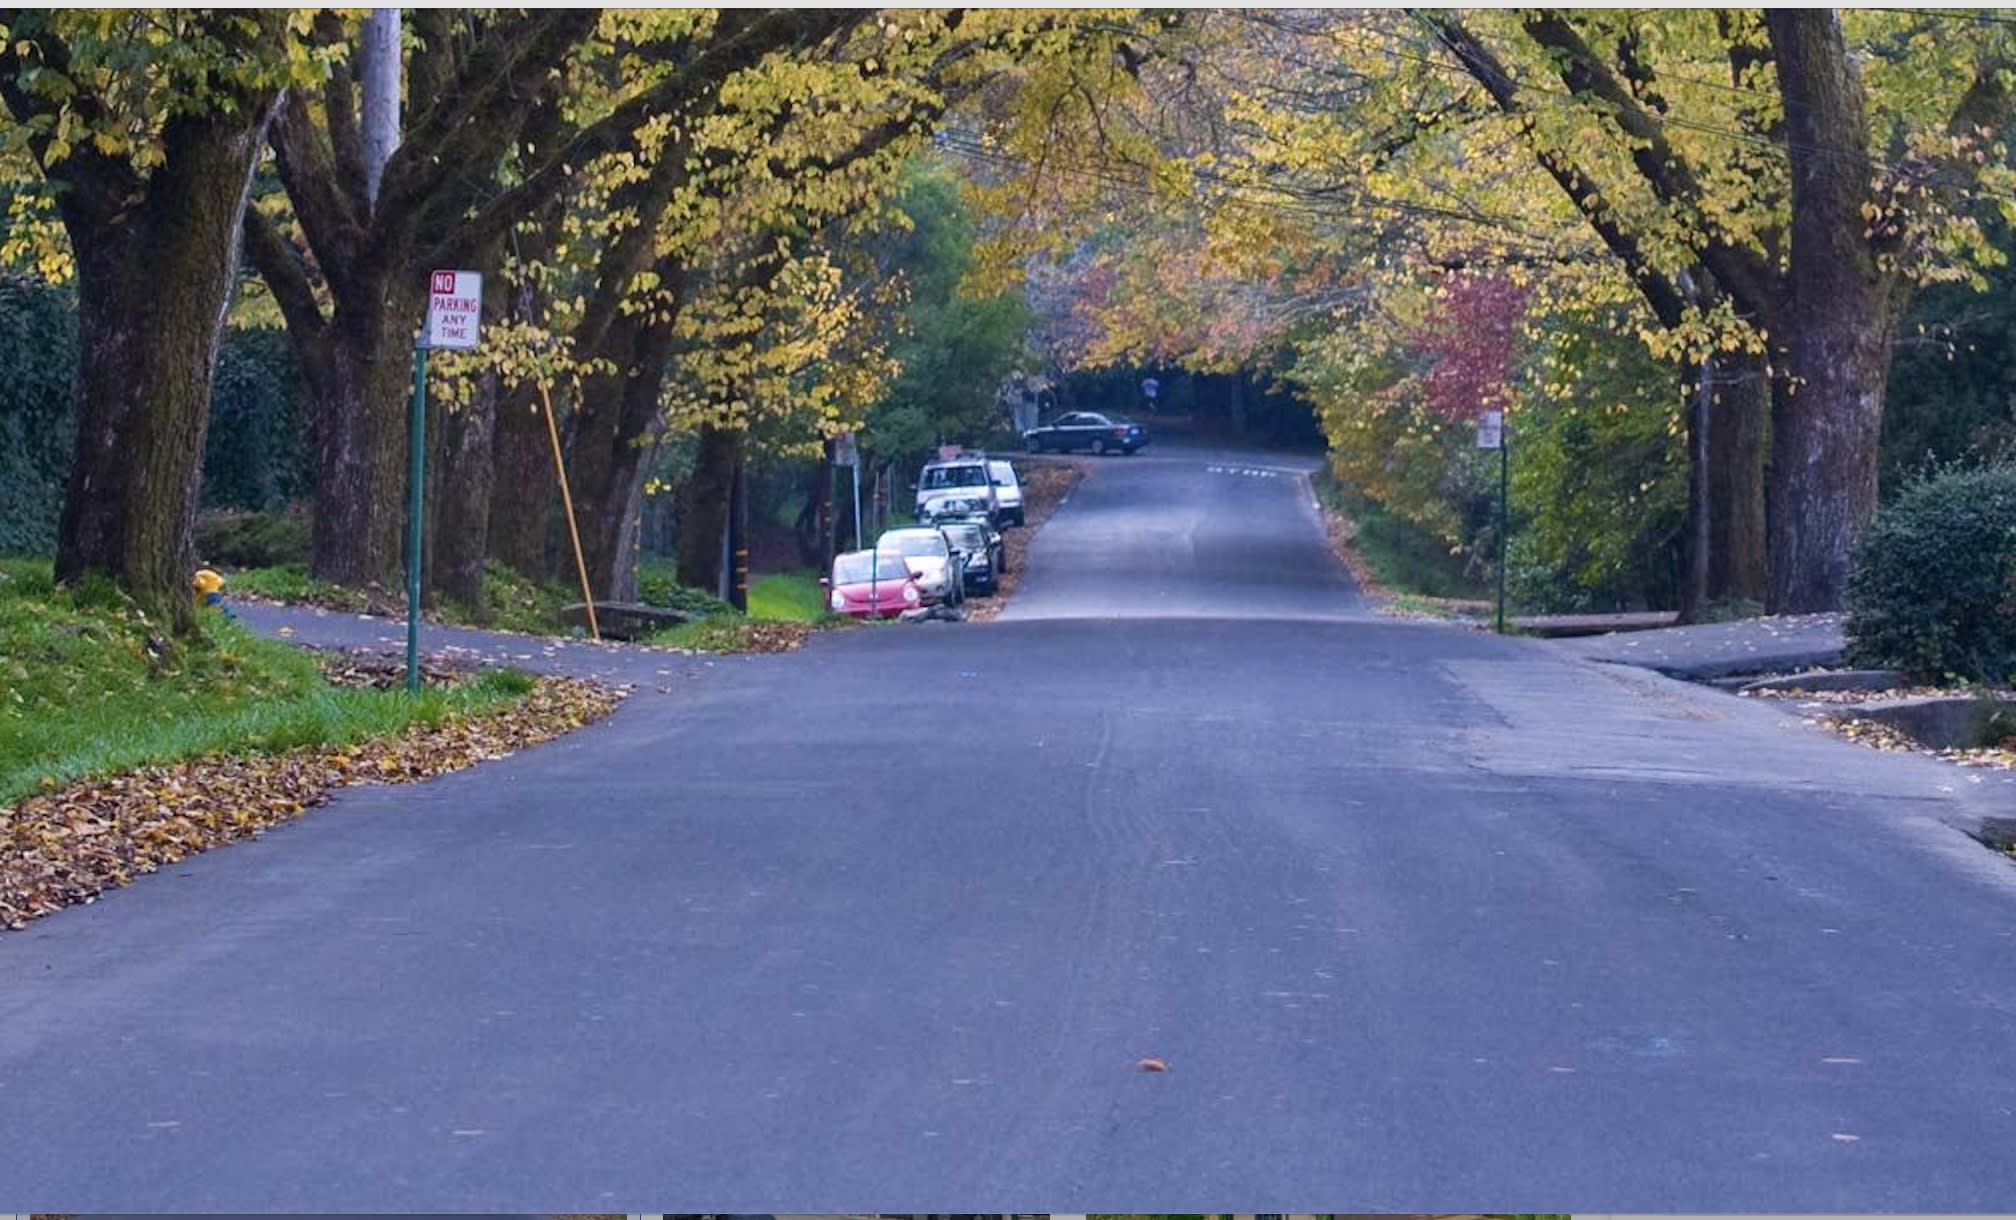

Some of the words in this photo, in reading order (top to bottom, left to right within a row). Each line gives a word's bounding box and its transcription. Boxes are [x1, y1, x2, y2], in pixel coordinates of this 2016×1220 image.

[434, 274, 454, 292] NO
[434, 297, 476, 312] PARKING
[441, 315, 467, 325] ANY
[442, 327, 466, 339] TIME
